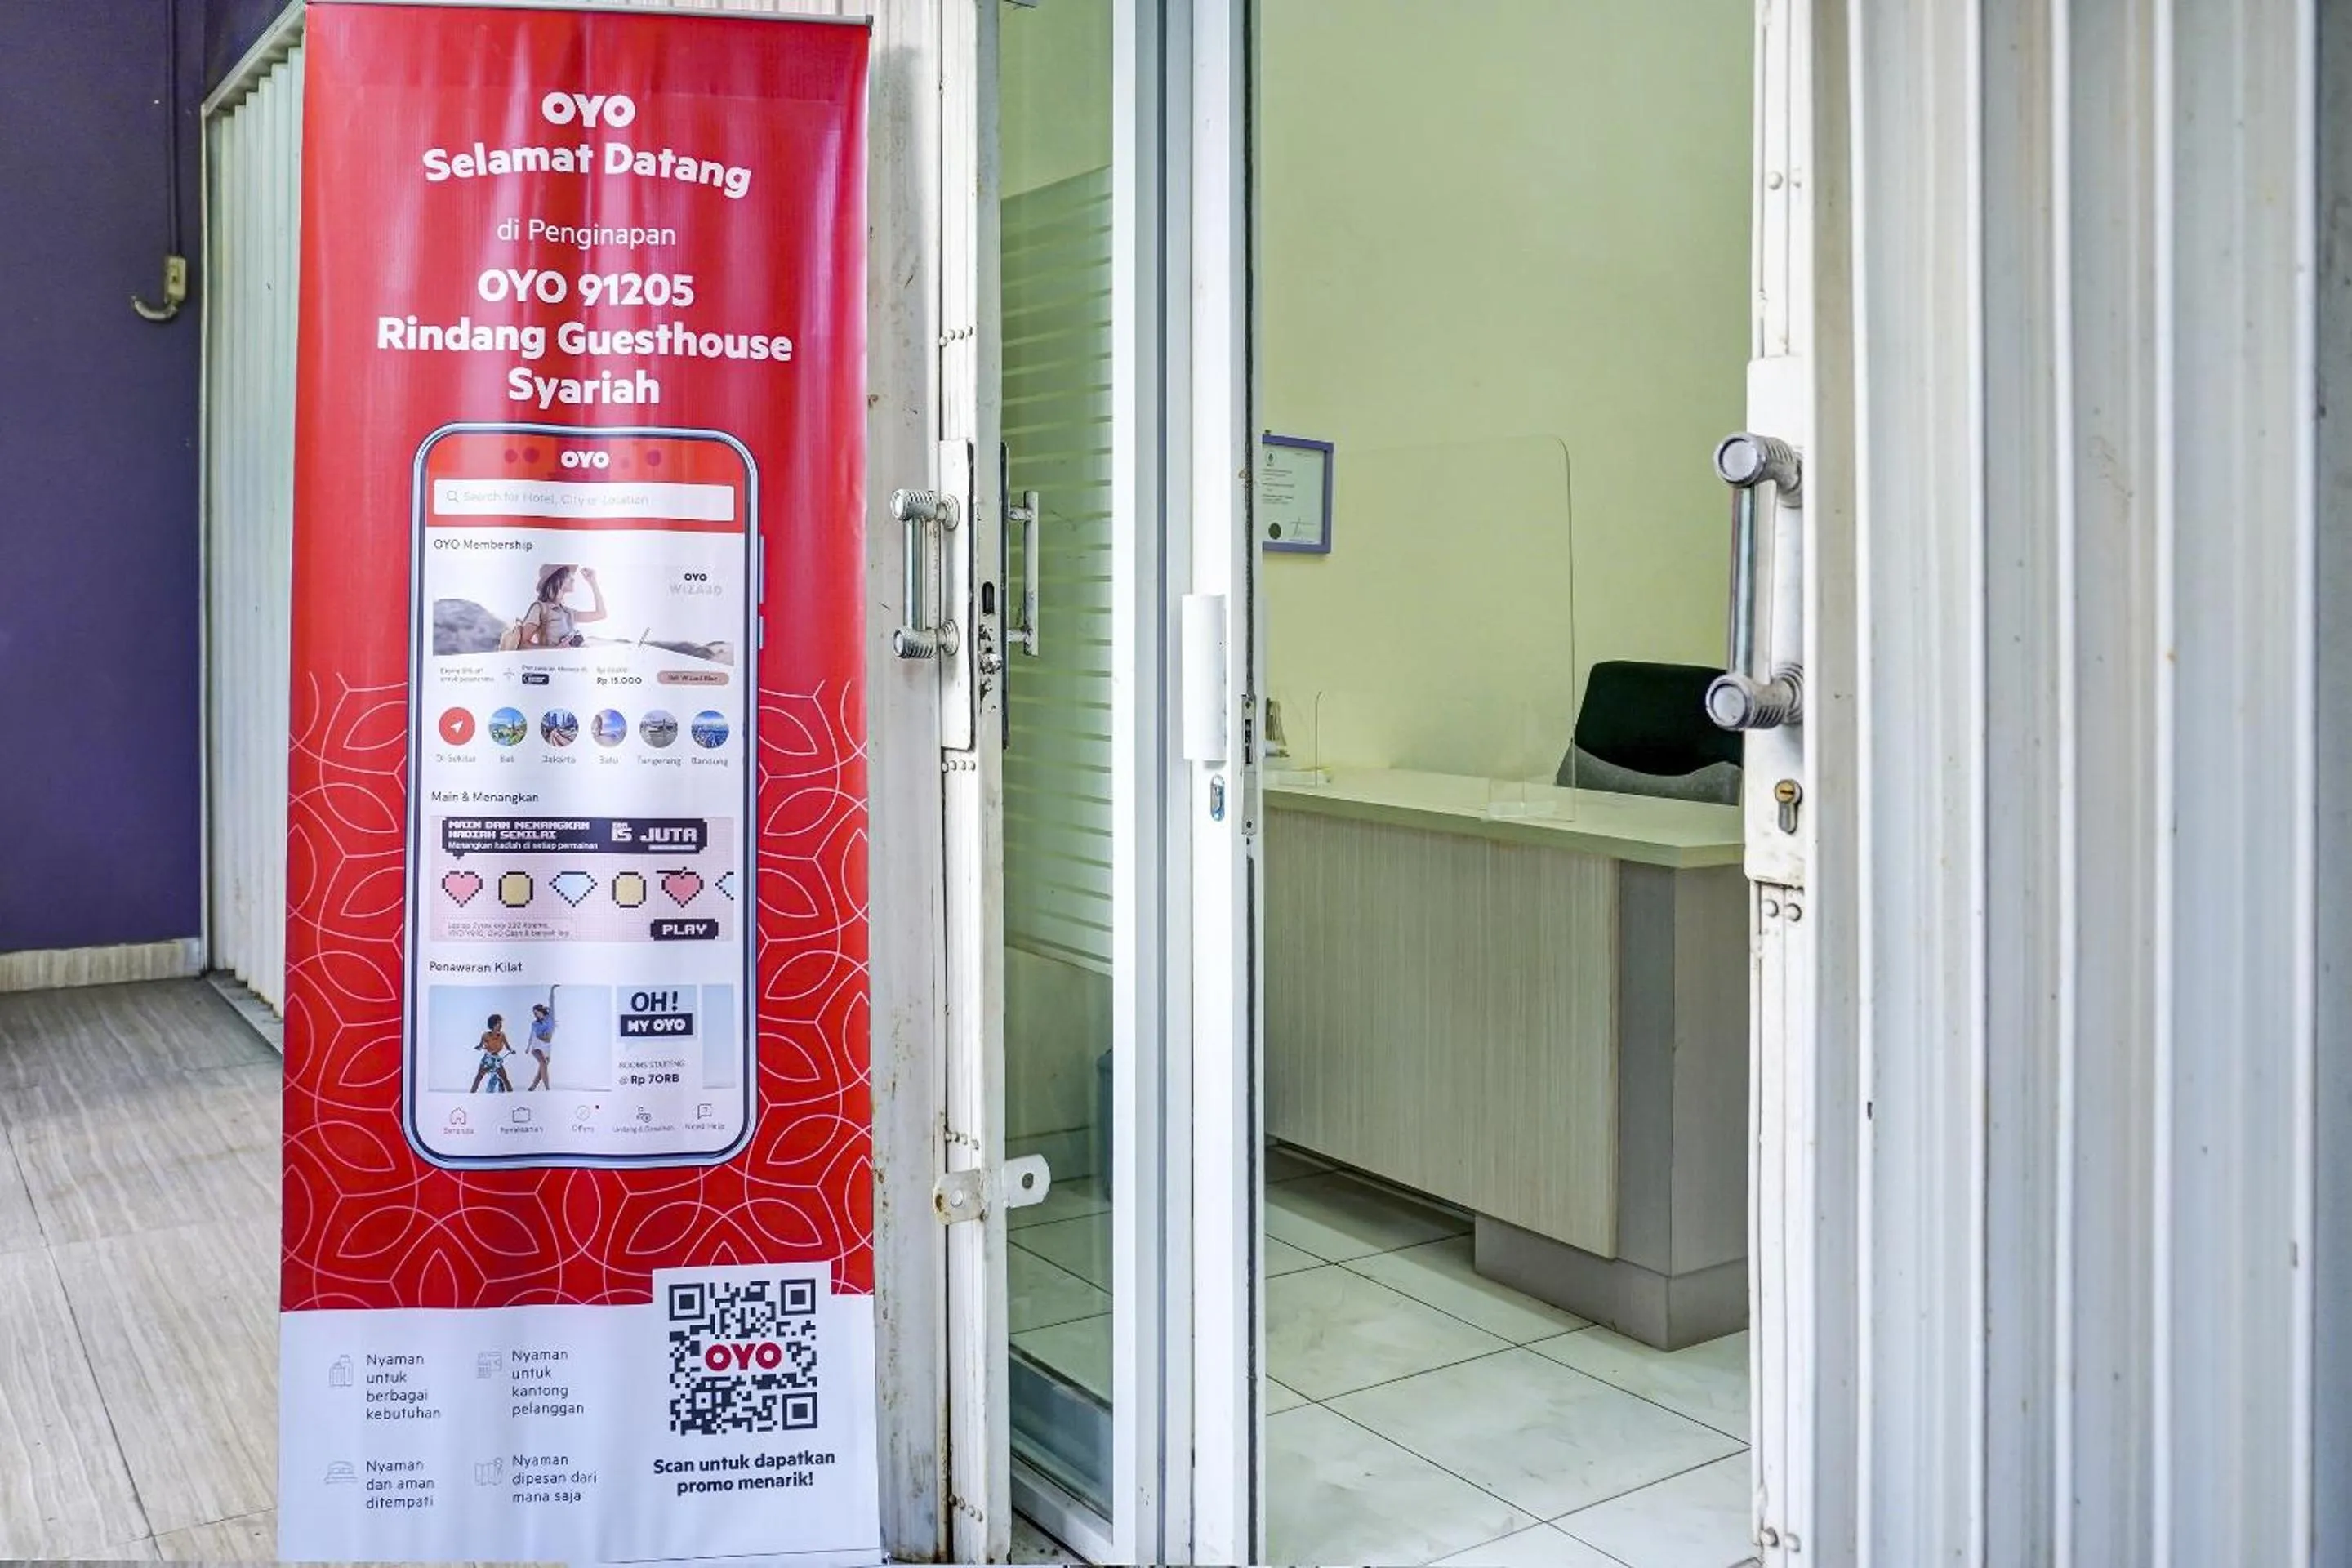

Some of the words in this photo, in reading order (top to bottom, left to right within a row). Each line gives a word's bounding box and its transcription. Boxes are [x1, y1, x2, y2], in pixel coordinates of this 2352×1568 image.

[541, 92, 636, 127] OYO
[422, 142, 593, 181] Selamat
[604, 142, 752, 198] Datang
[497, 219, 519, 242] di
[528, 220, 676, 250] Penginapan
[478, 270, 567, 303] OYO
[578, 274, 694, 306] 91205
[377, 316, 546, 359] Rindang
[558, 321, 793, 362] Guesthouse
[508, 367, 660, 409] Syariah
[560, 451, 610, 469] OYO
[434, 539, 460, 550] OYO
[463, 539, 533, 551] Membership
[684, 573, 707, 581] OYO
[597, 677, 608, 686] Rp
[431, 791, 458, 802] Main
[462, 791, 470, 802] &
[473, 791, 539, 804] Menangkan
[448, 821, 482, 829] MAIN
[484, 821, 510, 830] DAN
[514, 821, 590, 831] MENANGKAN
[448, 831, 496, 840] HADIAH
[499, 831, 557, 840] SENILAI
[639, 826, 697, 842] JUTA
[662, 924, 708, 936] PLAY
[430, 961, 492, 972] Penawaran
[495, 962, 523, 973] Kilat
[627, 1020, 650, 1033] MY
[653, 1018, 686, 1032] OYO
[630, 1075, 645, 1086] Rp
[366, 1354, 425, 1367] Nyaman
[511, 1349, 569, 1362] Nyaman
[705, 1342, 782, 1372] OYO
[366, 1372, 408, 1384] untuk
[511, 1365, 552, 1379] untuk
[366, 1389, 429, 1404] berbagai
[511, 1385, 569, 1399] kantong
[366, 1408, 441, 1420] kebutuhan
[511, 1402, 585, 1418] pelanggan
[366, 1460, 425, 1473] Nyaman
[511, 1454, 569, 1468] Nyaman
[653, 1459, 694, 1474] Scan
[699, 1454, 750, 1472] untuk
[754, 1450, 835, 1469] dapatkan
[366, 1479, 392, 1490] dan
[397, 1479, 435, 1490] aman
[511, 1472, 568, 1486] dipesan
[571, 1472, 598, 1484] dari
[676, 1479, 733, 1496] promo
[737, 1472, 814, 1490] menarik!
[366, 1495, 434, 1511] ditempati
[511, 1490, 550, 1503] mana
[554, 1490, 581, 1504] saja
